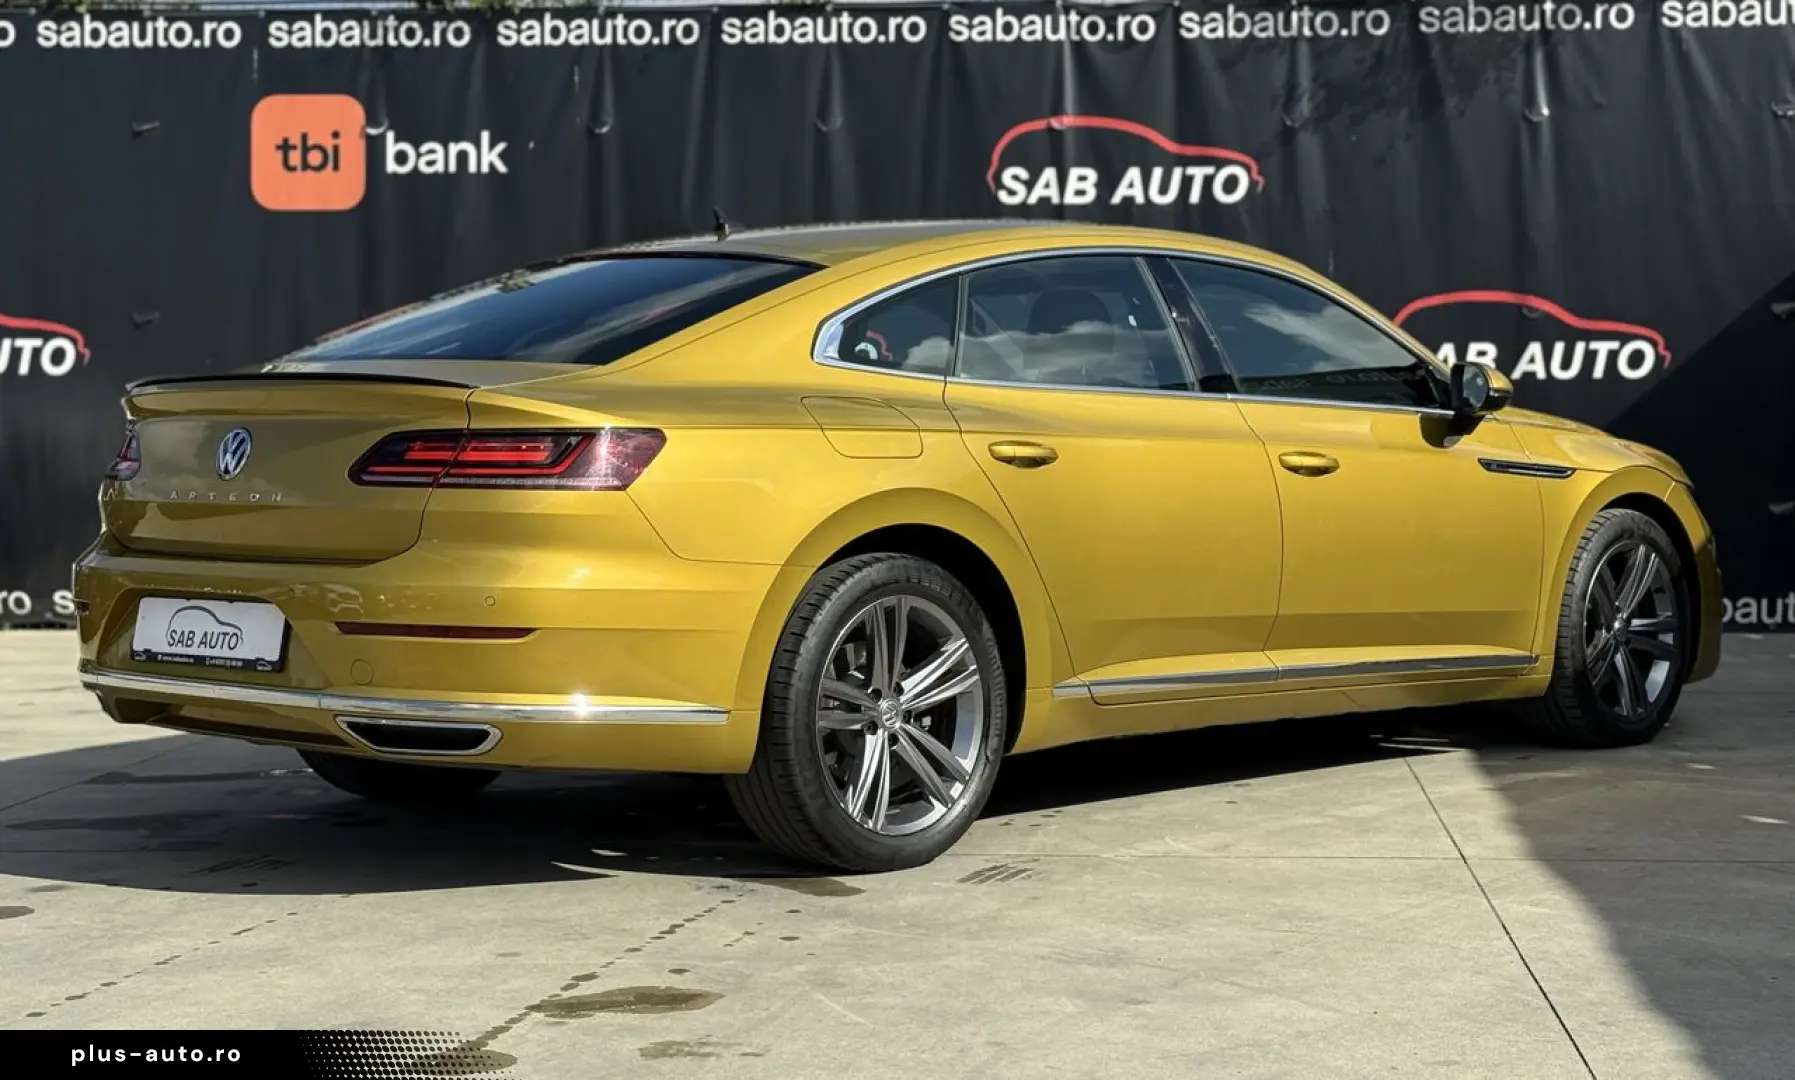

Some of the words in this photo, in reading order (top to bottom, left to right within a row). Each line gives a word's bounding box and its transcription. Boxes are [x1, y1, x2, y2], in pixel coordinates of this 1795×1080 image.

[36, 13, 242, 48] sabauto.ro
[268, 13, 471, 48] sabauto.ro
[497, 12, 700, 47] sabauto.ro
[721, 10, 927, 45] sabauto.ro
[949, 7, 1157, 44] sabauto.ro
[1178, 3, 1391, 40] sabauto.ro
[1418, 0, 1636, 33] sabauto.ro
[276, 131, 340, 173] tbi
[385, 130, 508, 174] bank
[997, 166, 1098, 205] SAB
[1110, 165, 1250, 205] AUTO
[1511, 339, 1657, 381] AUTO
[170, 489, 282, 502] ARTEON
[167, 629, 196, 649] SAB
[198, 630, 239, 651] AUTO
